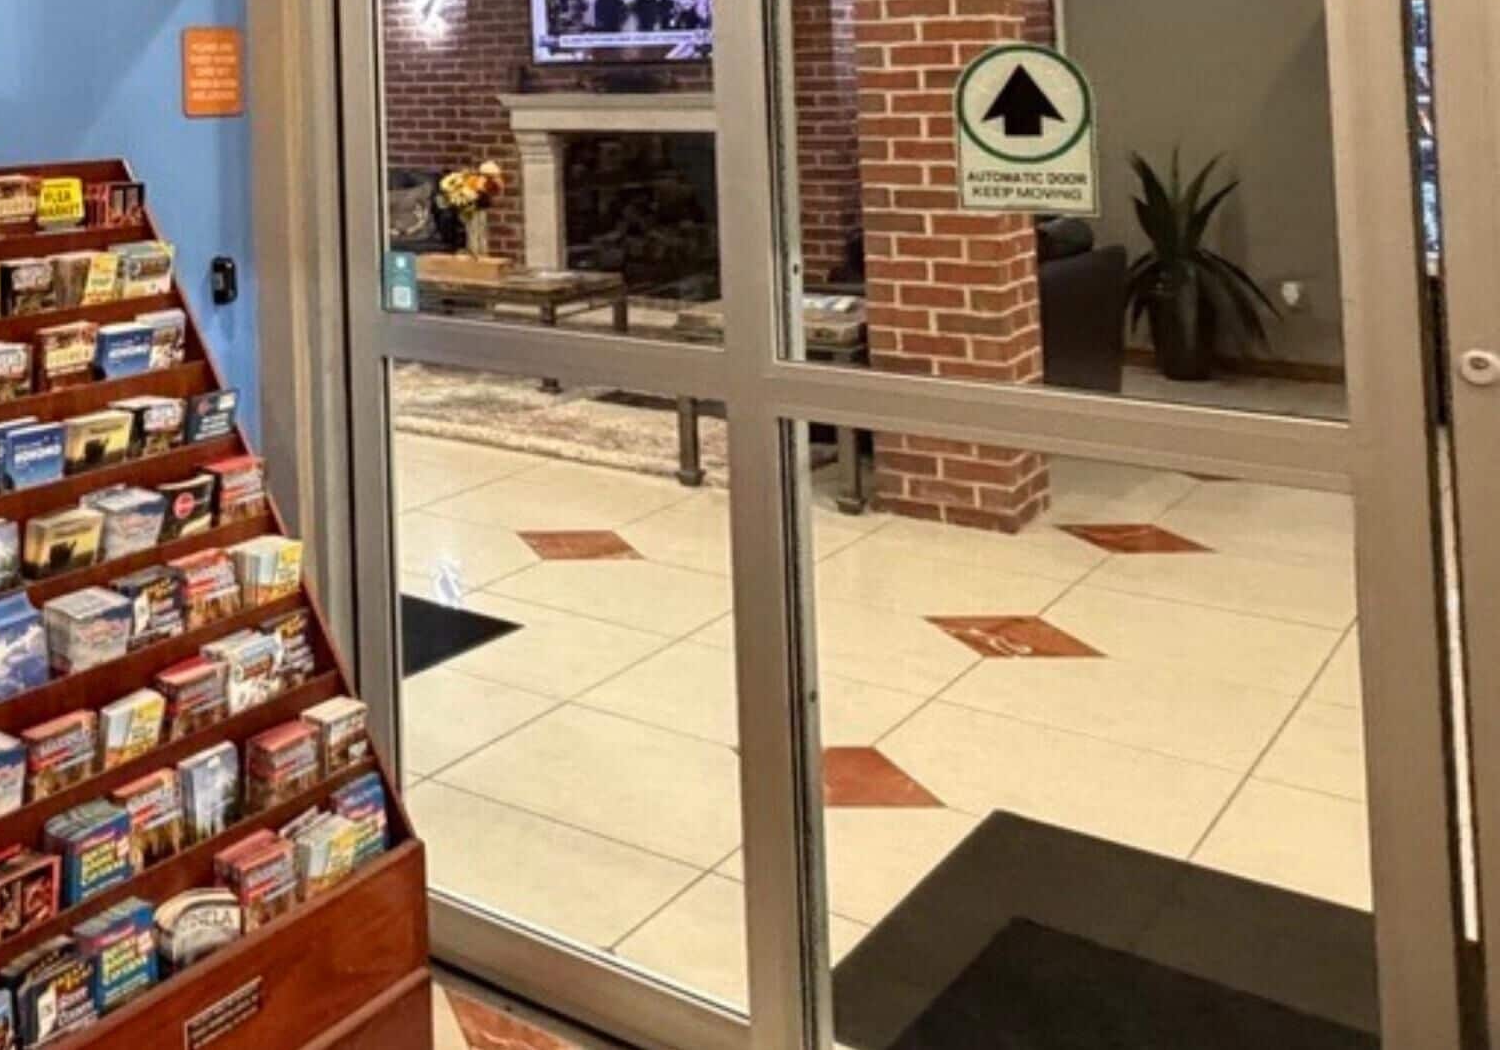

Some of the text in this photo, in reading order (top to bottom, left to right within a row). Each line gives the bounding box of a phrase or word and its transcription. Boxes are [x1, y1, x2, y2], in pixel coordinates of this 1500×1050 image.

[966, 170, 1088, 186] AUTOMATIC DOOR
[971, 186, 1083, 201] KEEP MOVING
